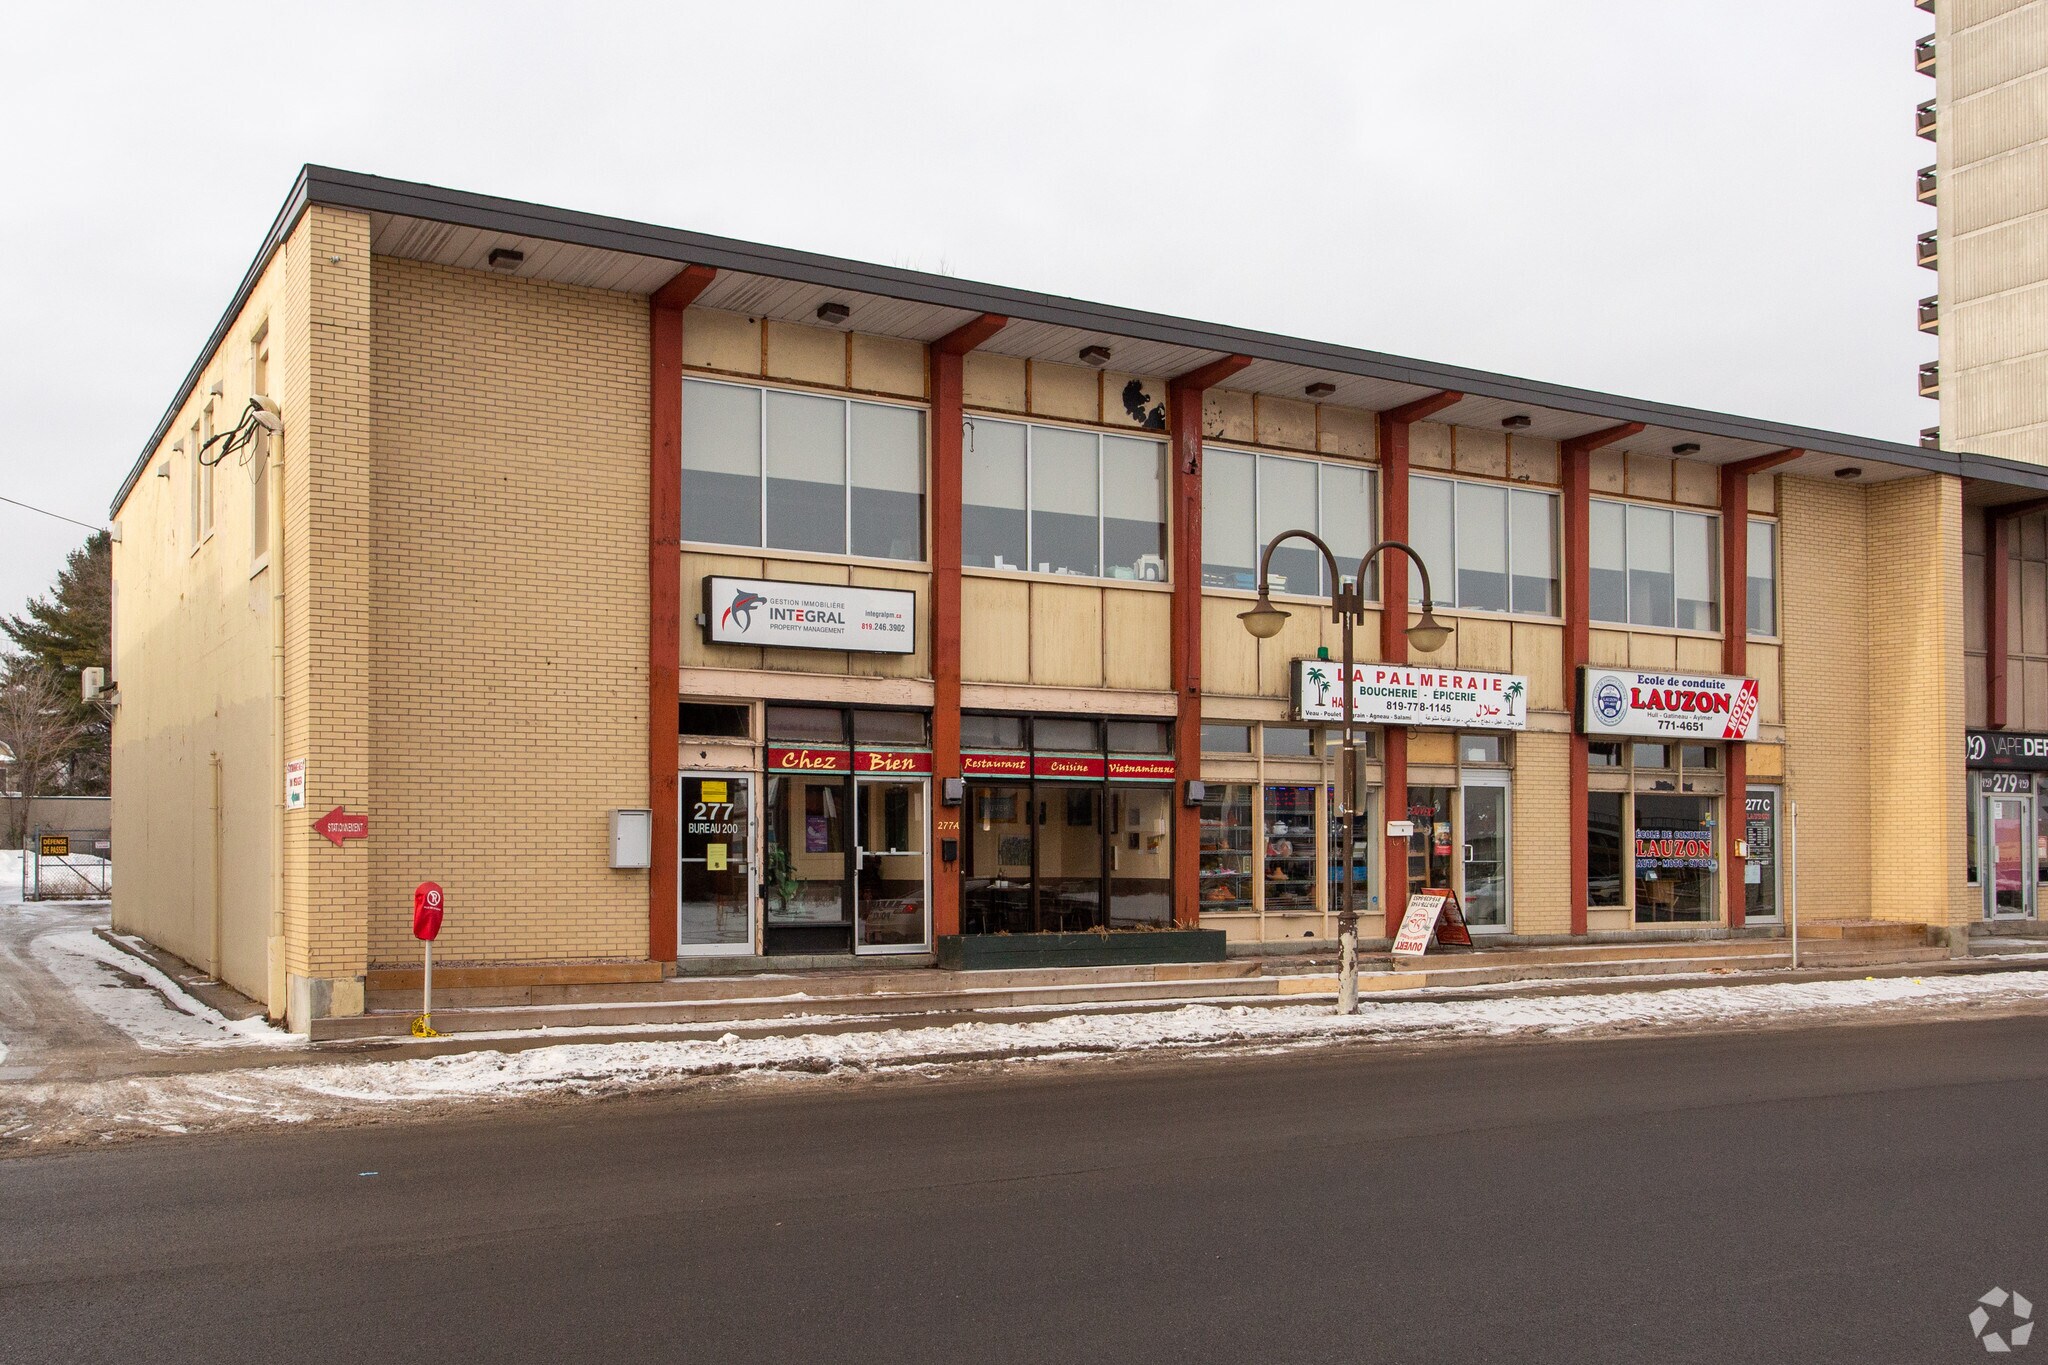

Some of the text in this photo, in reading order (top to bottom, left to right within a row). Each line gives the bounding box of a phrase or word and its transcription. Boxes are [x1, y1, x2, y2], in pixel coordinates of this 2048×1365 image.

[770, 598, 845, 610] GESTION IMMOBILIÈRE
[770, 608, 845, 624] INTEGRAL
[865, 610, 902, 619] integralpm.ca
[770, 624, 845, 634] PROPERTY MANAGEMENT
[861, 622, 905, 632] 819.246.3902
[1338, 668, 1502, 691] LA PALMERAIE
[1638, 674, 1726, 690] Ecole de conduite
[1360, 686, 1476, 702] BOUCHERIE ÉPICERIE
[1332, 696, 1358, 708] HAL
[1630, 687, 1732, 714] LAUZON
[1386, 701, 1451, 713] 819-778-1145
[1476, 704, 1500, 718] حلال
[1728, 688, 1748, 730] MOTO
[1738, 696, 1756, 736] AUTO
[1658, 720, 1704, 732] 771-4651
[1992, 736, 2024, 756] VAPE
[782, 750, 916, 771] Chez Bien
[964, 758, 1026, 770] Restaurant
[1050, 762, 1088, 772] Cuisine
[1109, 764, 1175, 774] Vietnamienne
[1993, 774, 2018, 792] 279
[694, 802, 734, 820] 277
[688, 822, 738, 834] BUREAU 200
[938, 821, 960, 830] 277A
[1636, 828, 1660, 838] ÉCOLE
[1662, 830, 1672, 838] DE
[1636, 840, 1712, 857] LAUZON
[1636, 859, 1658, 868] AUTO
[1662, 859, 1684, 868] MOTO
[1395, 941, 1423, 952] OUVERT
